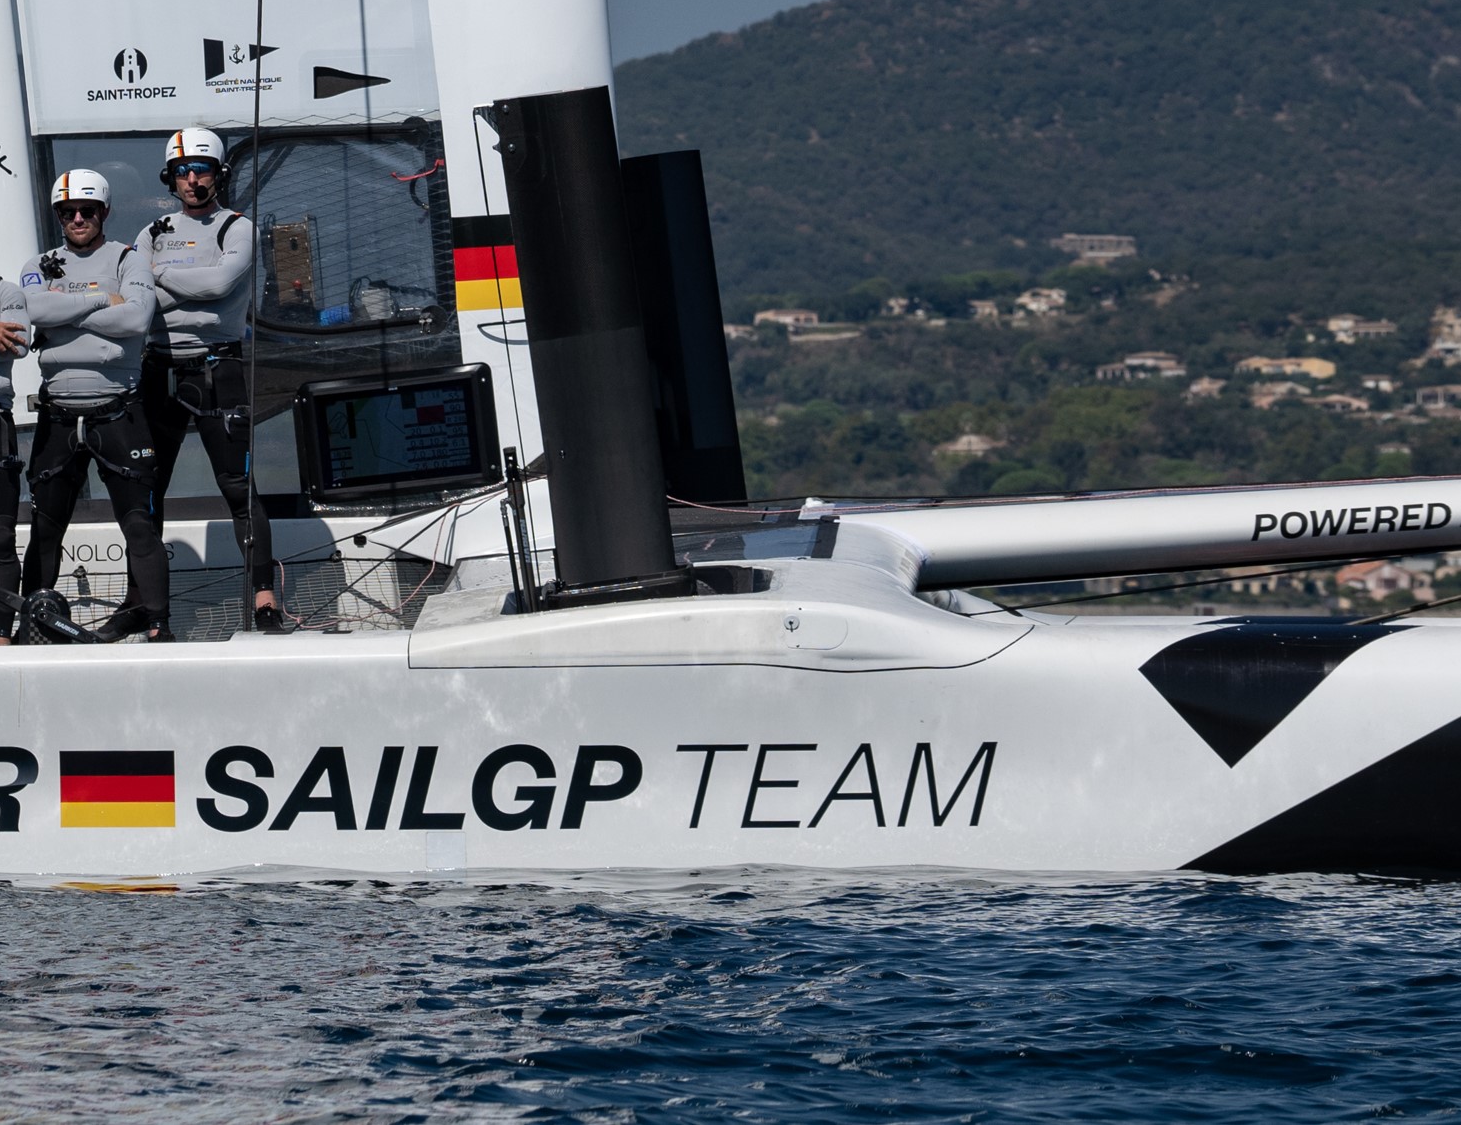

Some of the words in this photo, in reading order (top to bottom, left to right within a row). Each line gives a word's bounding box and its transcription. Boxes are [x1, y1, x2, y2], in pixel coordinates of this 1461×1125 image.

[205, 78, 239, 87] SOCIÉTÉ
[87, 86, 177, 102] SAINT-TROPEZ
[68, 281, 88, 289] GER
[1251, 502, 1452, 542] POWERED
[195, 743, 644, 833] SAILGP
[674, 740, 998, 830] TEAM
